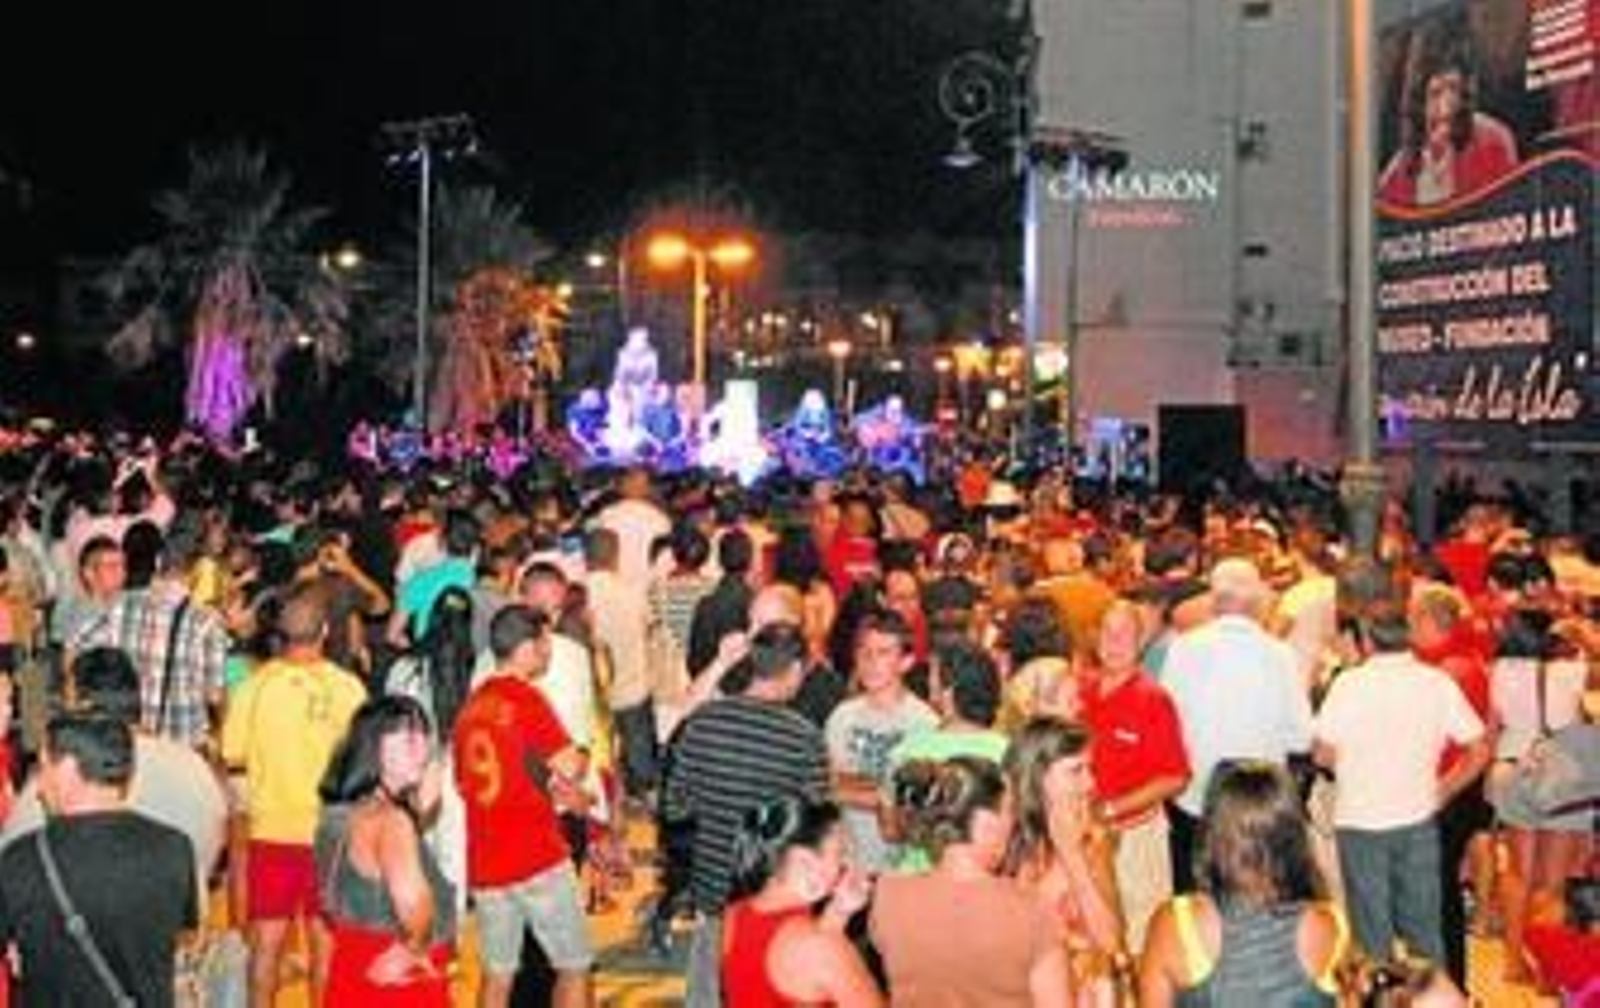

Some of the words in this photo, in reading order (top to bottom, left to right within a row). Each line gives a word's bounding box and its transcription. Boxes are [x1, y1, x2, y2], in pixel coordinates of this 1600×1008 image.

[1531, 208, 1546, 242] A
[1549, 203, 1577, 240] LA
[1511, 261, 1552, 295] DEL
[465, 729, 501, 805] 9
